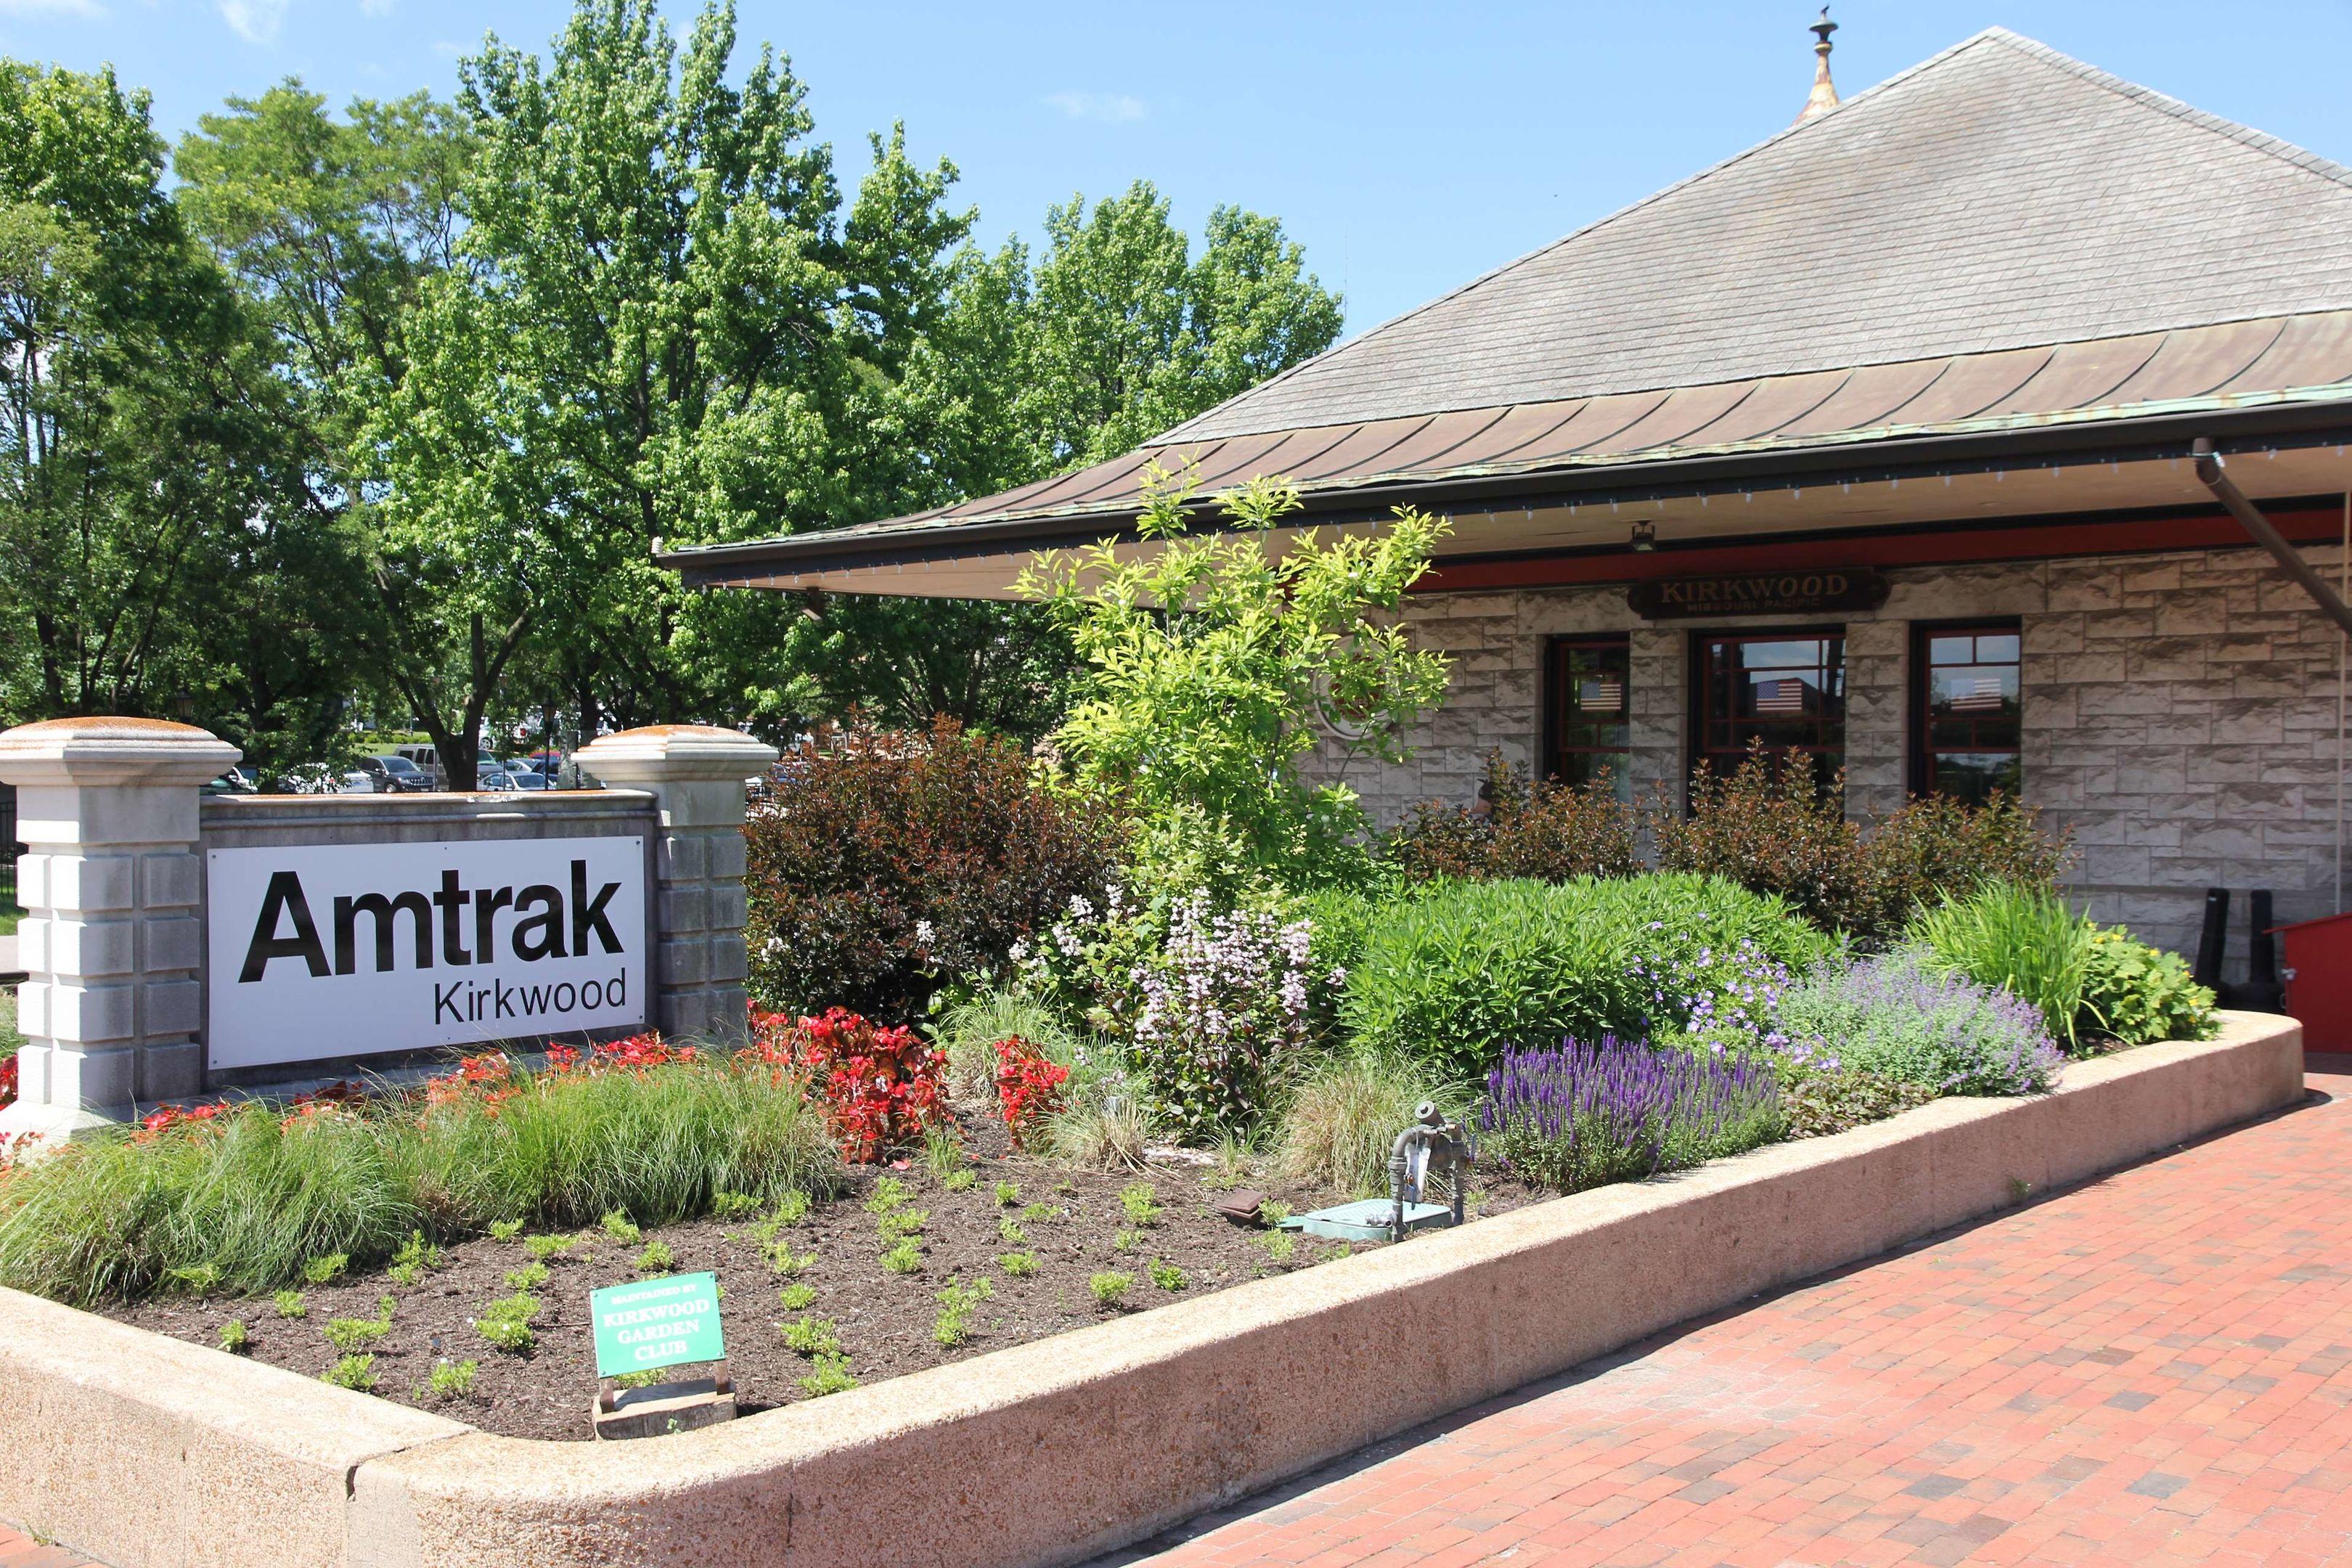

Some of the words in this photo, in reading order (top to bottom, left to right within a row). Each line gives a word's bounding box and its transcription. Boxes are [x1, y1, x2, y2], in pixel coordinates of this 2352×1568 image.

[1661, 574, 1847, 603] KIRKWOOD
[1688, 599, 1757, 612] MISSOURI
[1764, 597, 1821, 609] PACIFIC
[237, 859, 625, 984] Amtrak
[434, 967, 626, 1025] Kirkwood
[611, 1286, 680, 1304] MAINTAINED
[682, 1283, 697, 1294] BY
[603, 1299, 710, 1327] KIRKWOOD
[618, 1319, 701, 1344] GARDEN
[634, 1340, 687, 1361] CLUB
